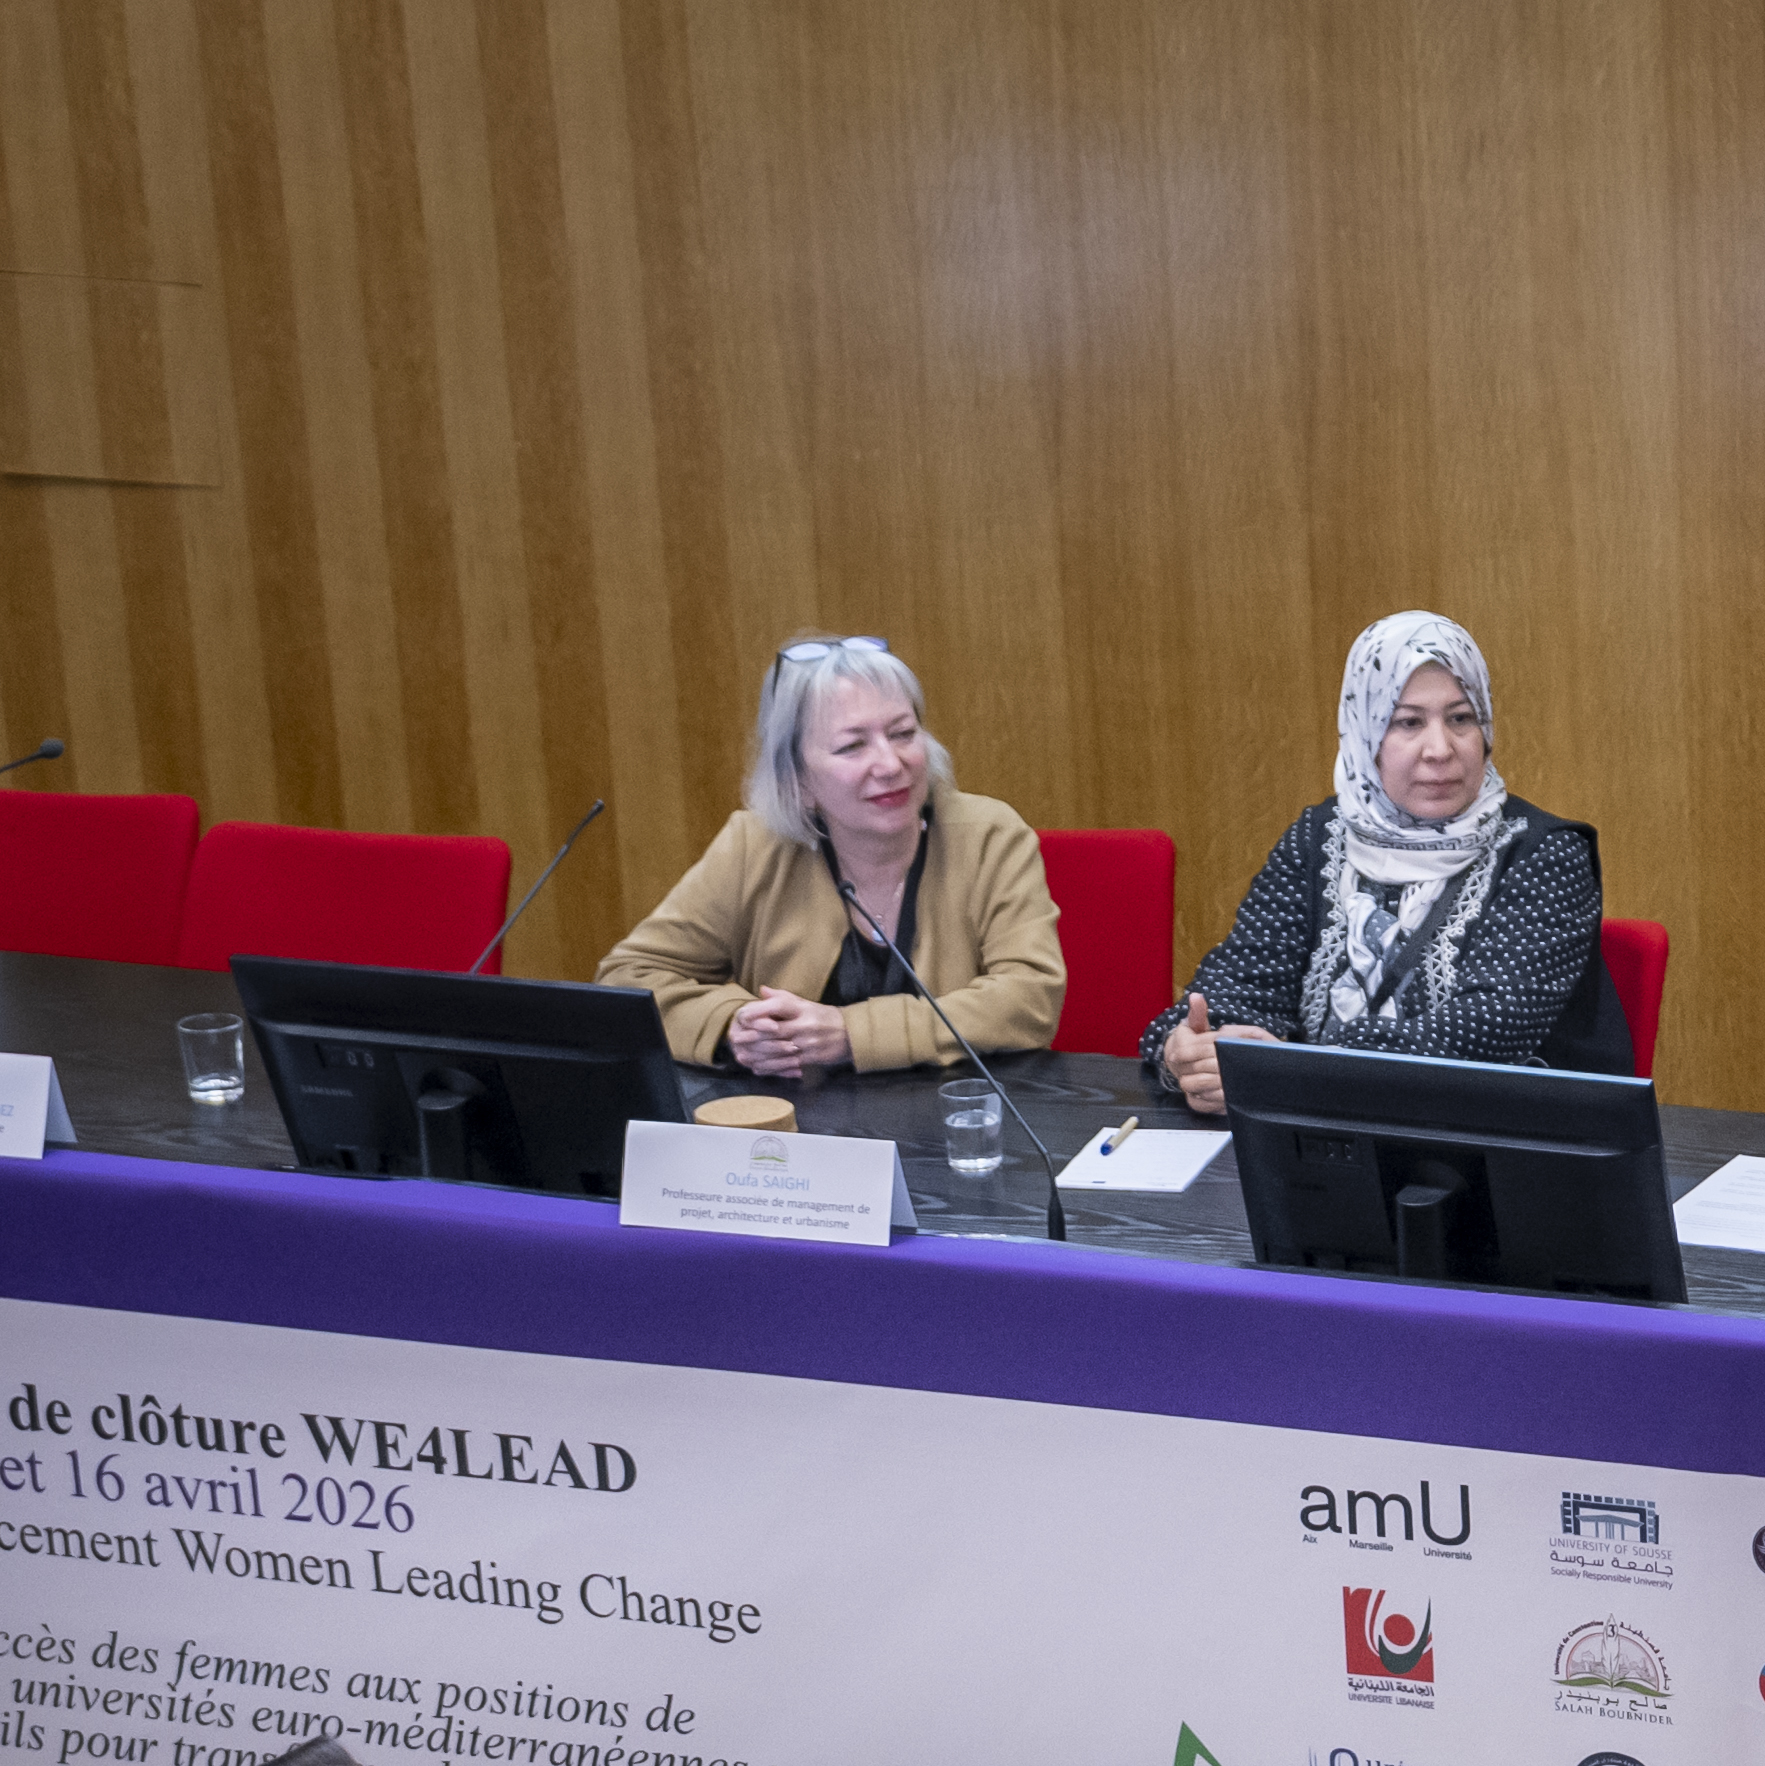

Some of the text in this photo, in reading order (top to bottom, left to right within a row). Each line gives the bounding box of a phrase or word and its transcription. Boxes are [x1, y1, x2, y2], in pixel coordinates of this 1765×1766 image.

[772, 1197, 784, 1208] de
[858, 1204, 870, 1214] de
[9, 1384, 638, 1494] de clôture WE4LEAD
[1, 1450, 415, 1533] et 16 avril 2026
[1300, 1480, 1471, 1546] amU
[1302, 1534, 1472, 1561] Aix Marseille Université
[1550, 1538, 1672, 1560] UNIVERSITY OF SOUSSE
[172, 1528, 352, 1590] Women
[371, 1550, 564, 1625] Leading
[580, 1574, 762, 1644] Change
[1551, 1567, 1672, 1590] Socially Responsible University
[12, 1678, 236, 1731] universités
[92, 1631, 159, 1675] des
[173, 1639, 330, 1694] femmes
[346, 1671, 421, 1704] aux
[436, 1681, 629, 1730] positions
[646, 1694, 696, 1735] de
[1555, 1701, 1673, 1725] SALAH BOUBNIDER
[59, 1724, 158, 1766] pour
